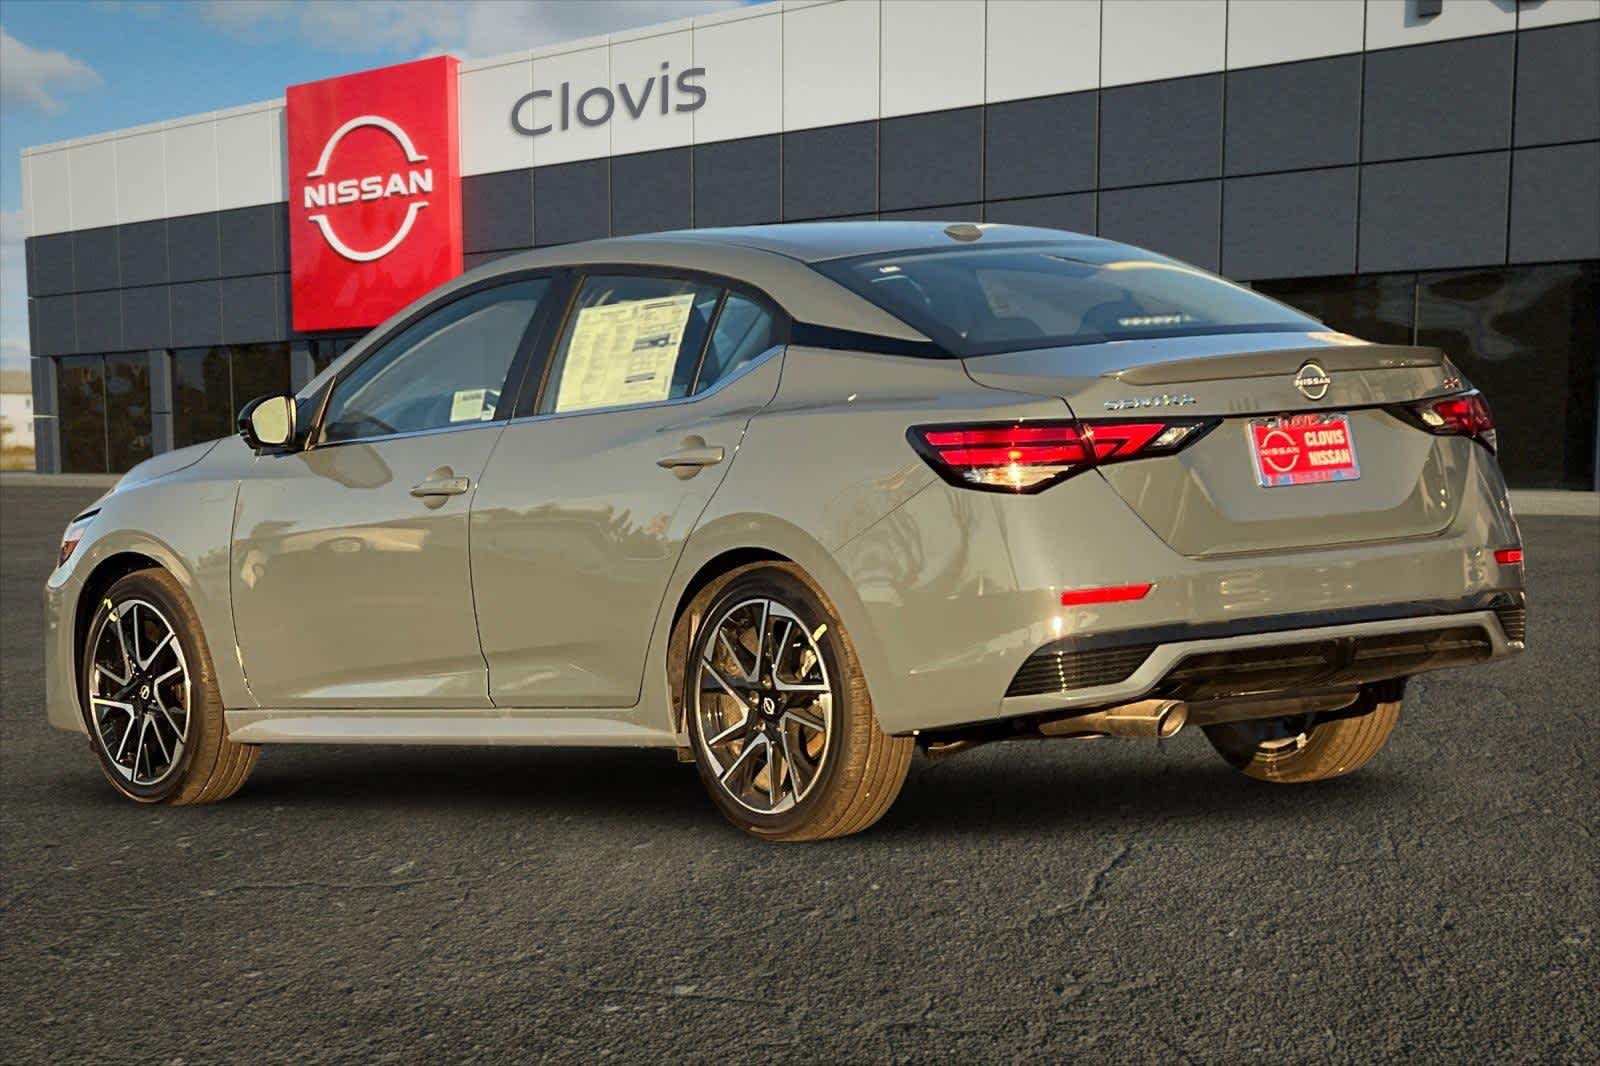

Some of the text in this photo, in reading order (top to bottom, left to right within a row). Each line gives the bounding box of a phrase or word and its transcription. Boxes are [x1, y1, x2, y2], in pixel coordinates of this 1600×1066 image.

[511, 62, 707, 136] Clovis
[304, 168, 433, 208] NISSAN
[1294, 377, 1330, 387] NISSAN
[1304, 430, 1345, 447] CLOVIS
[1261, 446, 1300, 456] NISSAN
[1308, 449, 1351, 466] NISSAN
